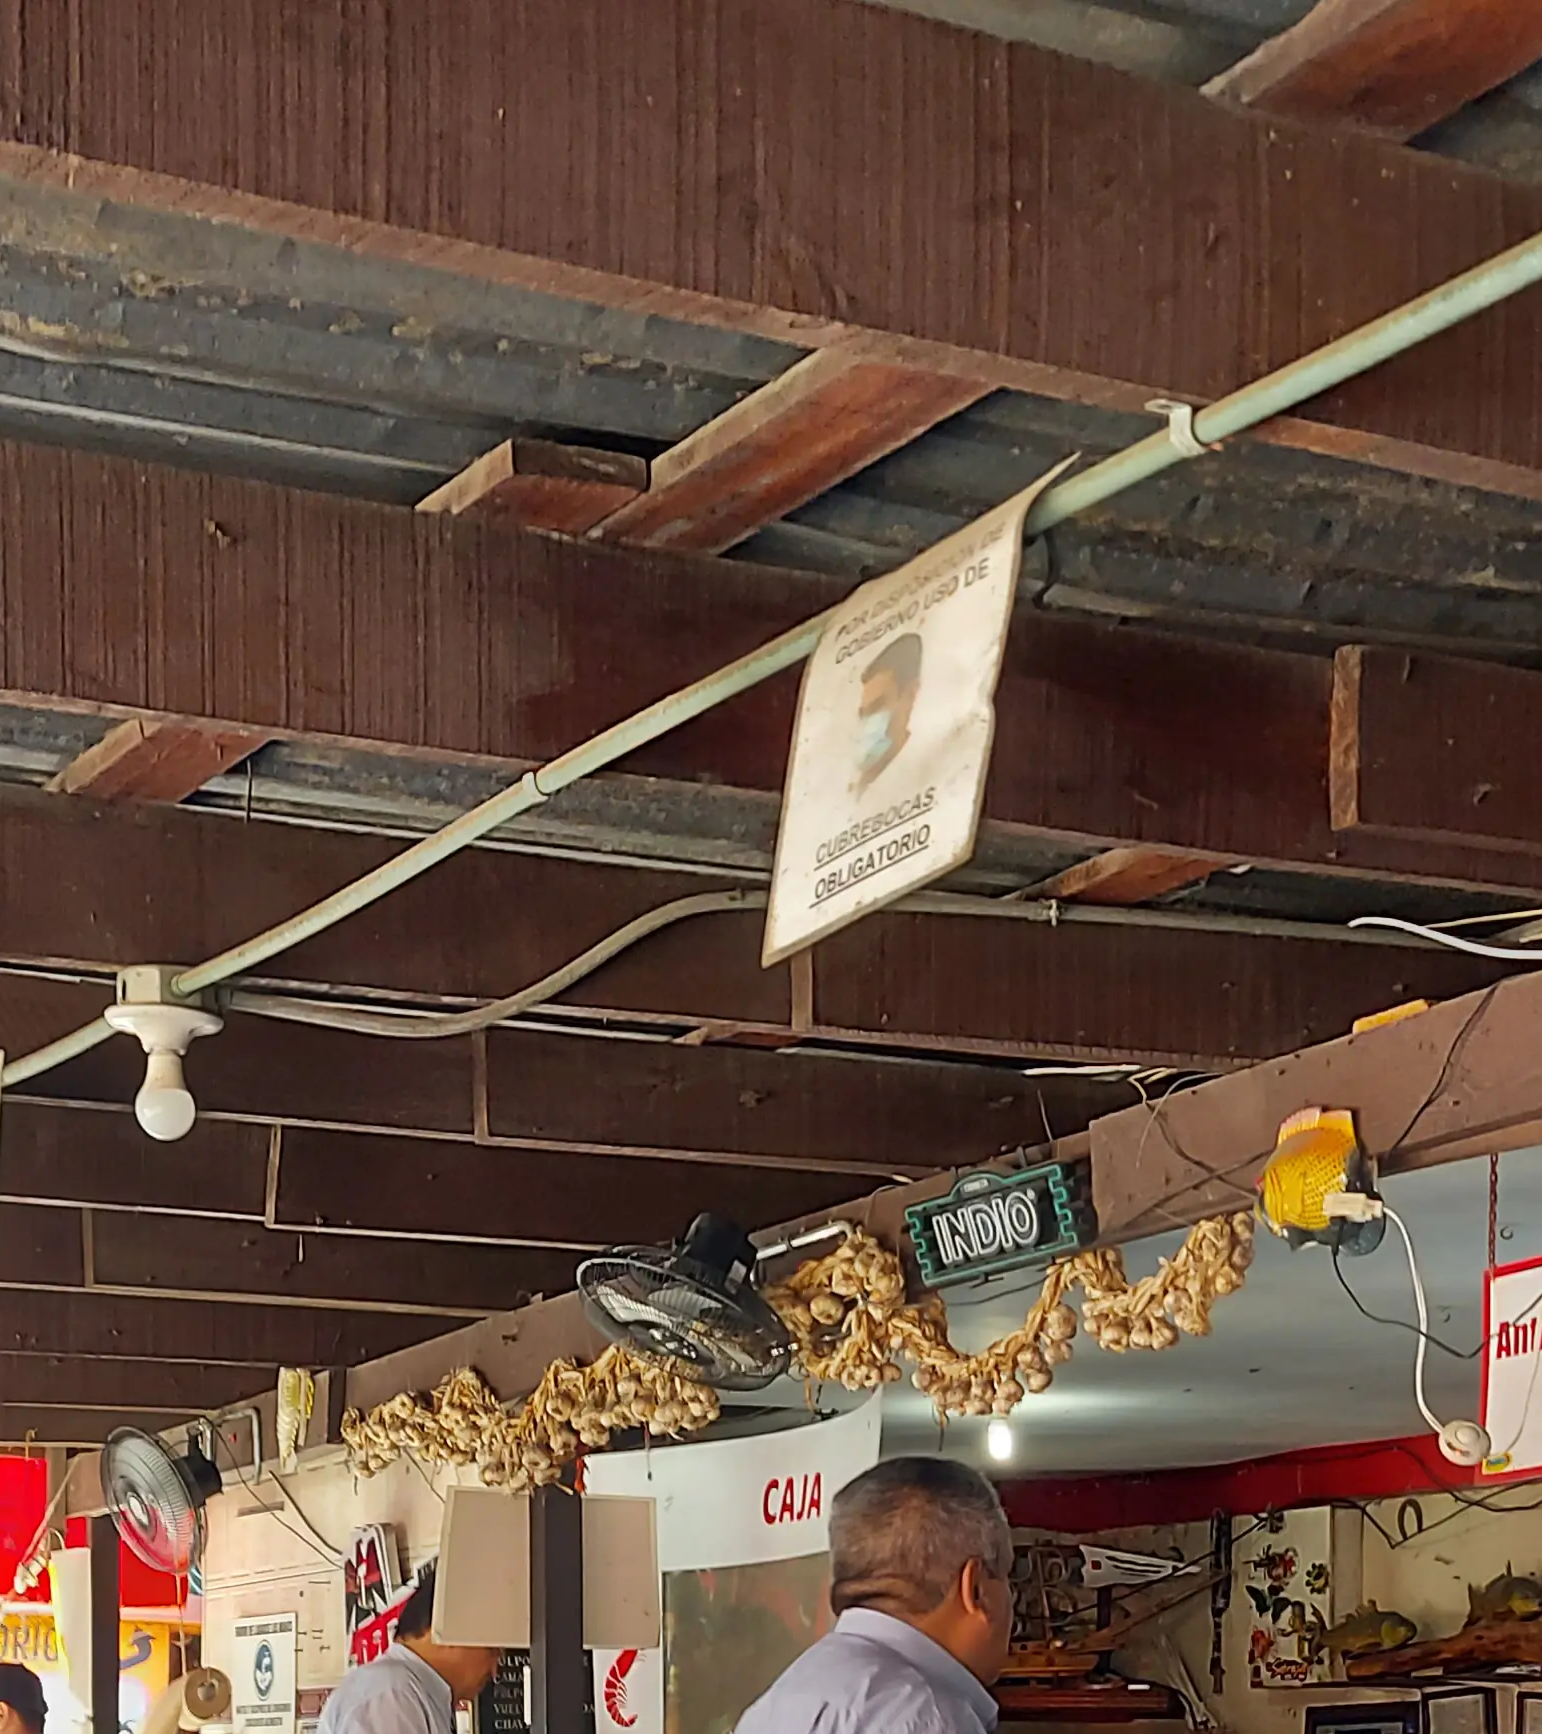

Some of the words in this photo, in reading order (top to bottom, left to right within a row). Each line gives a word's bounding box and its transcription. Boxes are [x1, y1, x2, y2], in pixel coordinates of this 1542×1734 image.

[835, 600, 920, 665] GOBIERNO
[923, 575, 959, 610] USO
[963, 556, 990, 588] DE
[814, 823, 931, 900] OBLIGATORIO
[815, 786, 936, 865] CUBREBOCAS
[931, 1190, 1038, 1266] INDIO
[762, 1471, 822, 1526] CAJA
